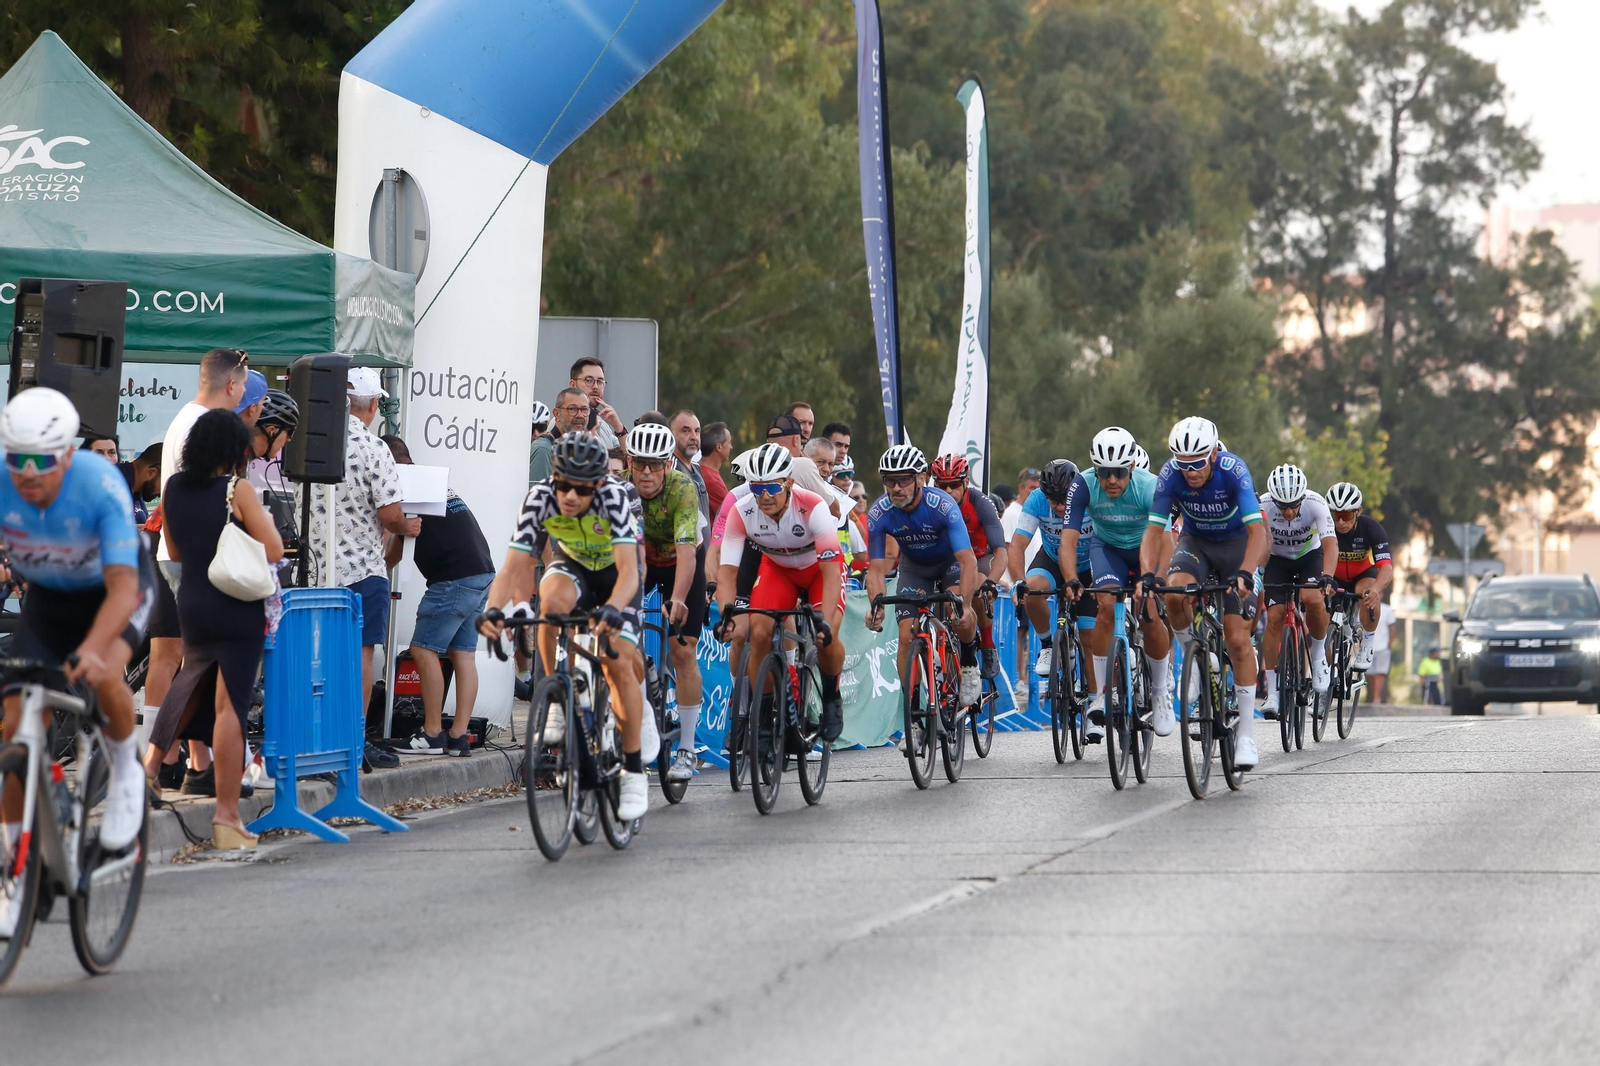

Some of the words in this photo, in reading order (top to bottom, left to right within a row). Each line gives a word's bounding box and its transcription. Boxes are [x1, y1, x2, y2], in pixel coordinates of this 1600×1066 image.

[424, 413, 498, 453] Cádiz
[1063, 482, 1080, 526] ROCKRIDER
[1183, 500, 1230, 513] MIRANDA
